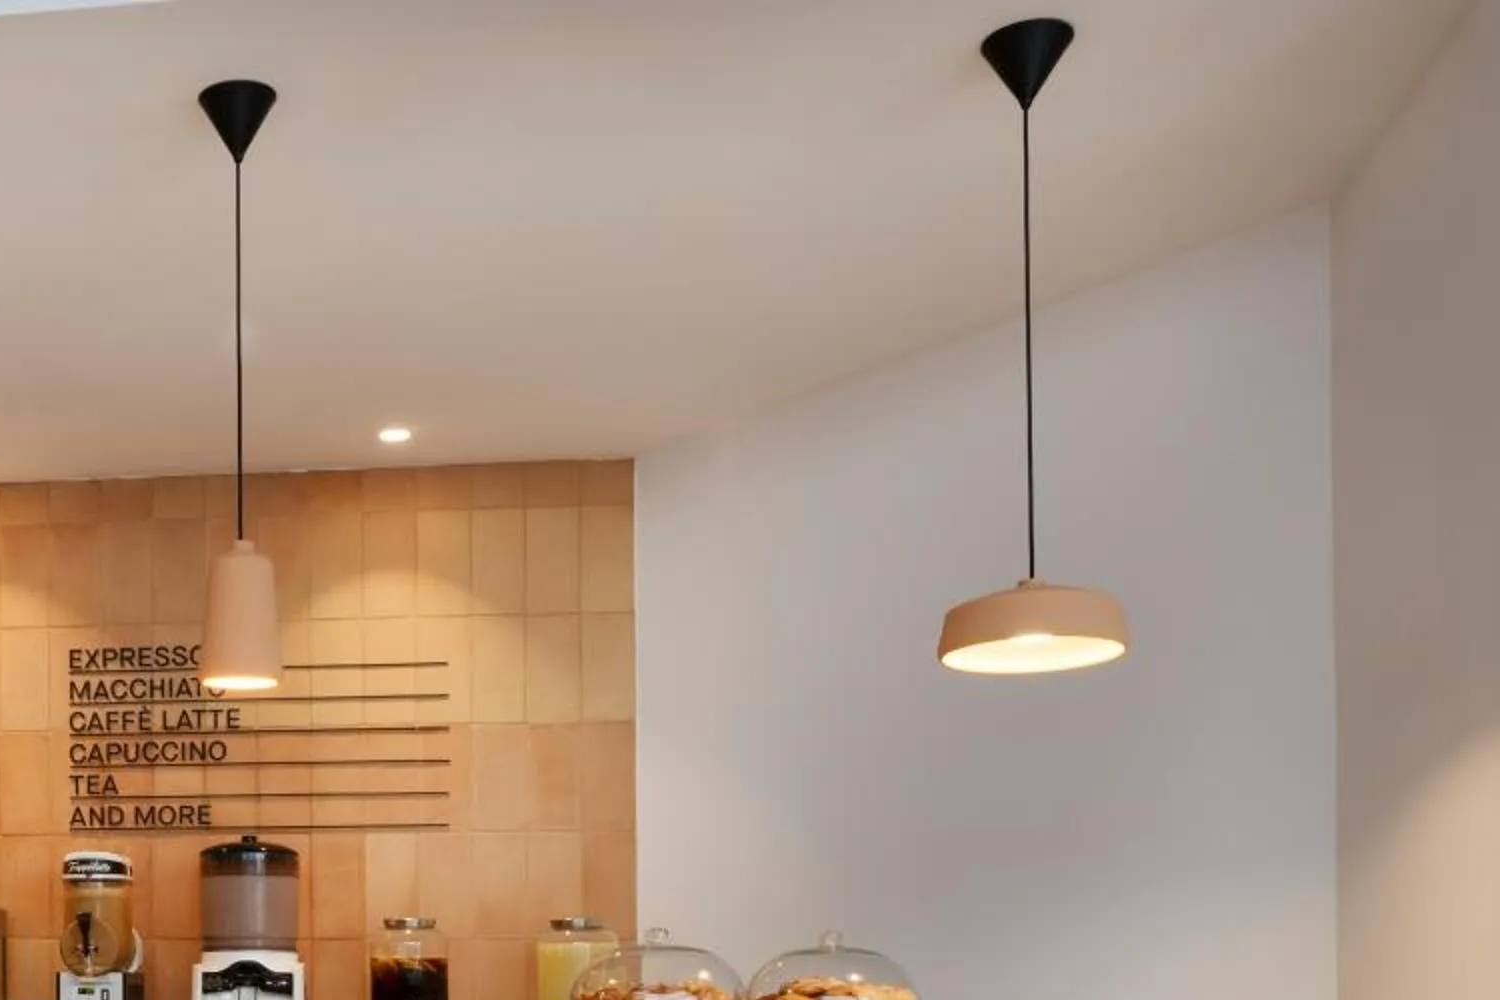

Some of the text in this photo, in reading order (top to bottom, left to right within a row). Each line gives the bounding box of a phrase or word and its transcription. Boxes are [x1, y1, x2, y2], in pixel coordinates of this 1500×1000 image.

[69, 706, 241, 732] CAFFÈ LATTE
[69, 740, 227, 764] CAPUCCINO
[69, 774, 119, 796] TEA
[70, 804, 212, 827] AND MORE
